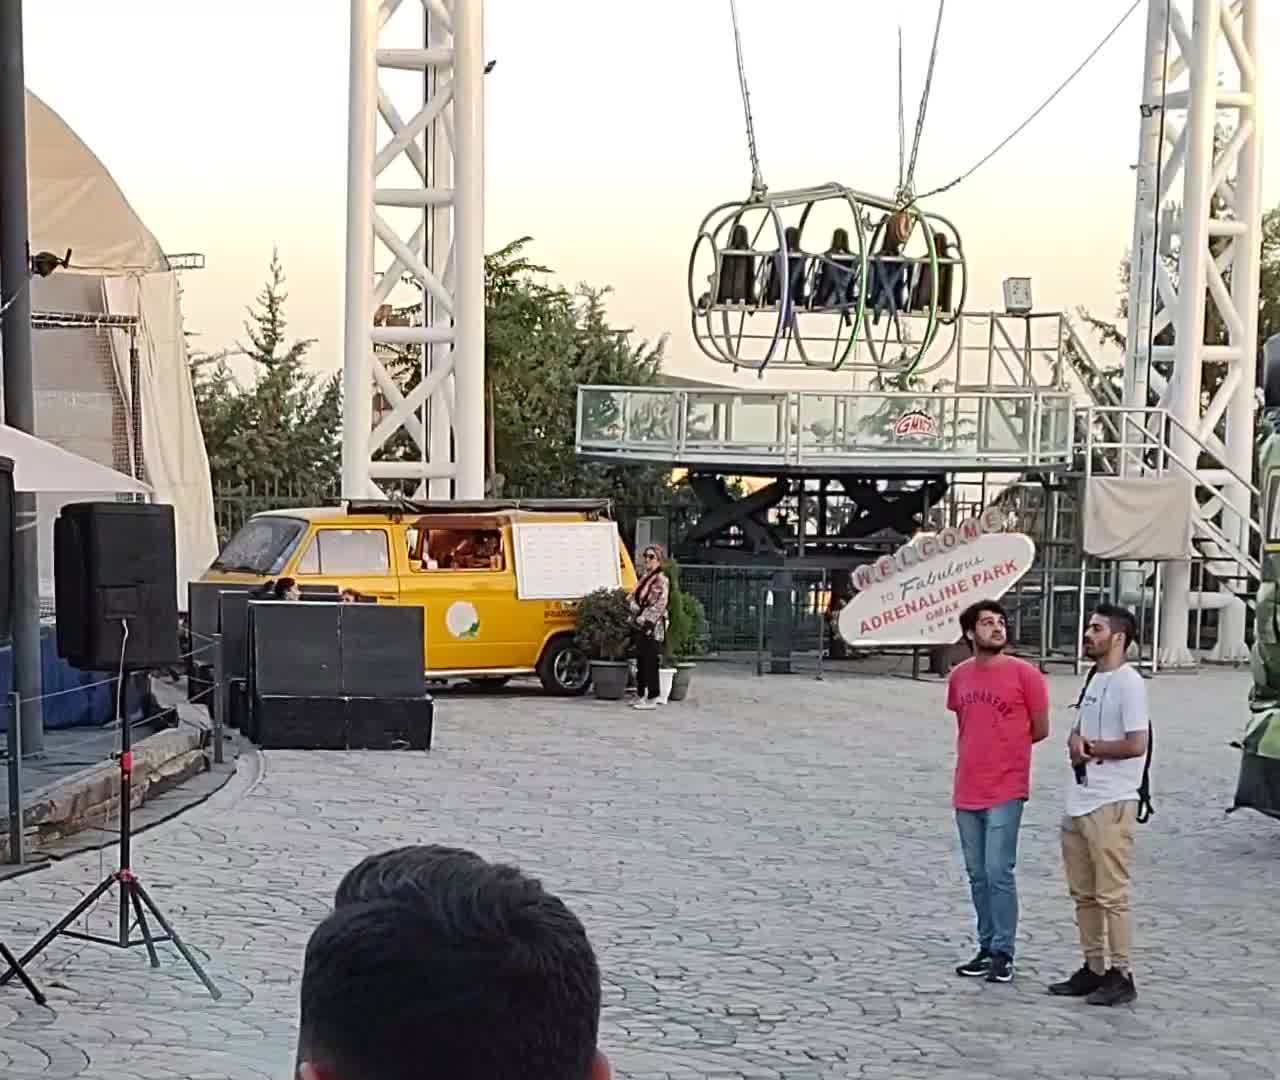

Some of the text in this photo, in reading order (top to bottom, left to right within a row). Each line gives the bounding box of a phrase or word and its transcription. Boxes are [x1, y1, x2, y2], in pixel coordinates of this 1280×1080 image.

[856, 512, 1002, 588] WELCOME
[900, 556, 985, 601] Fabulous
[860, 582, 969, 636] ADRENALINE
[971, 558, 1019, 588] PARK
